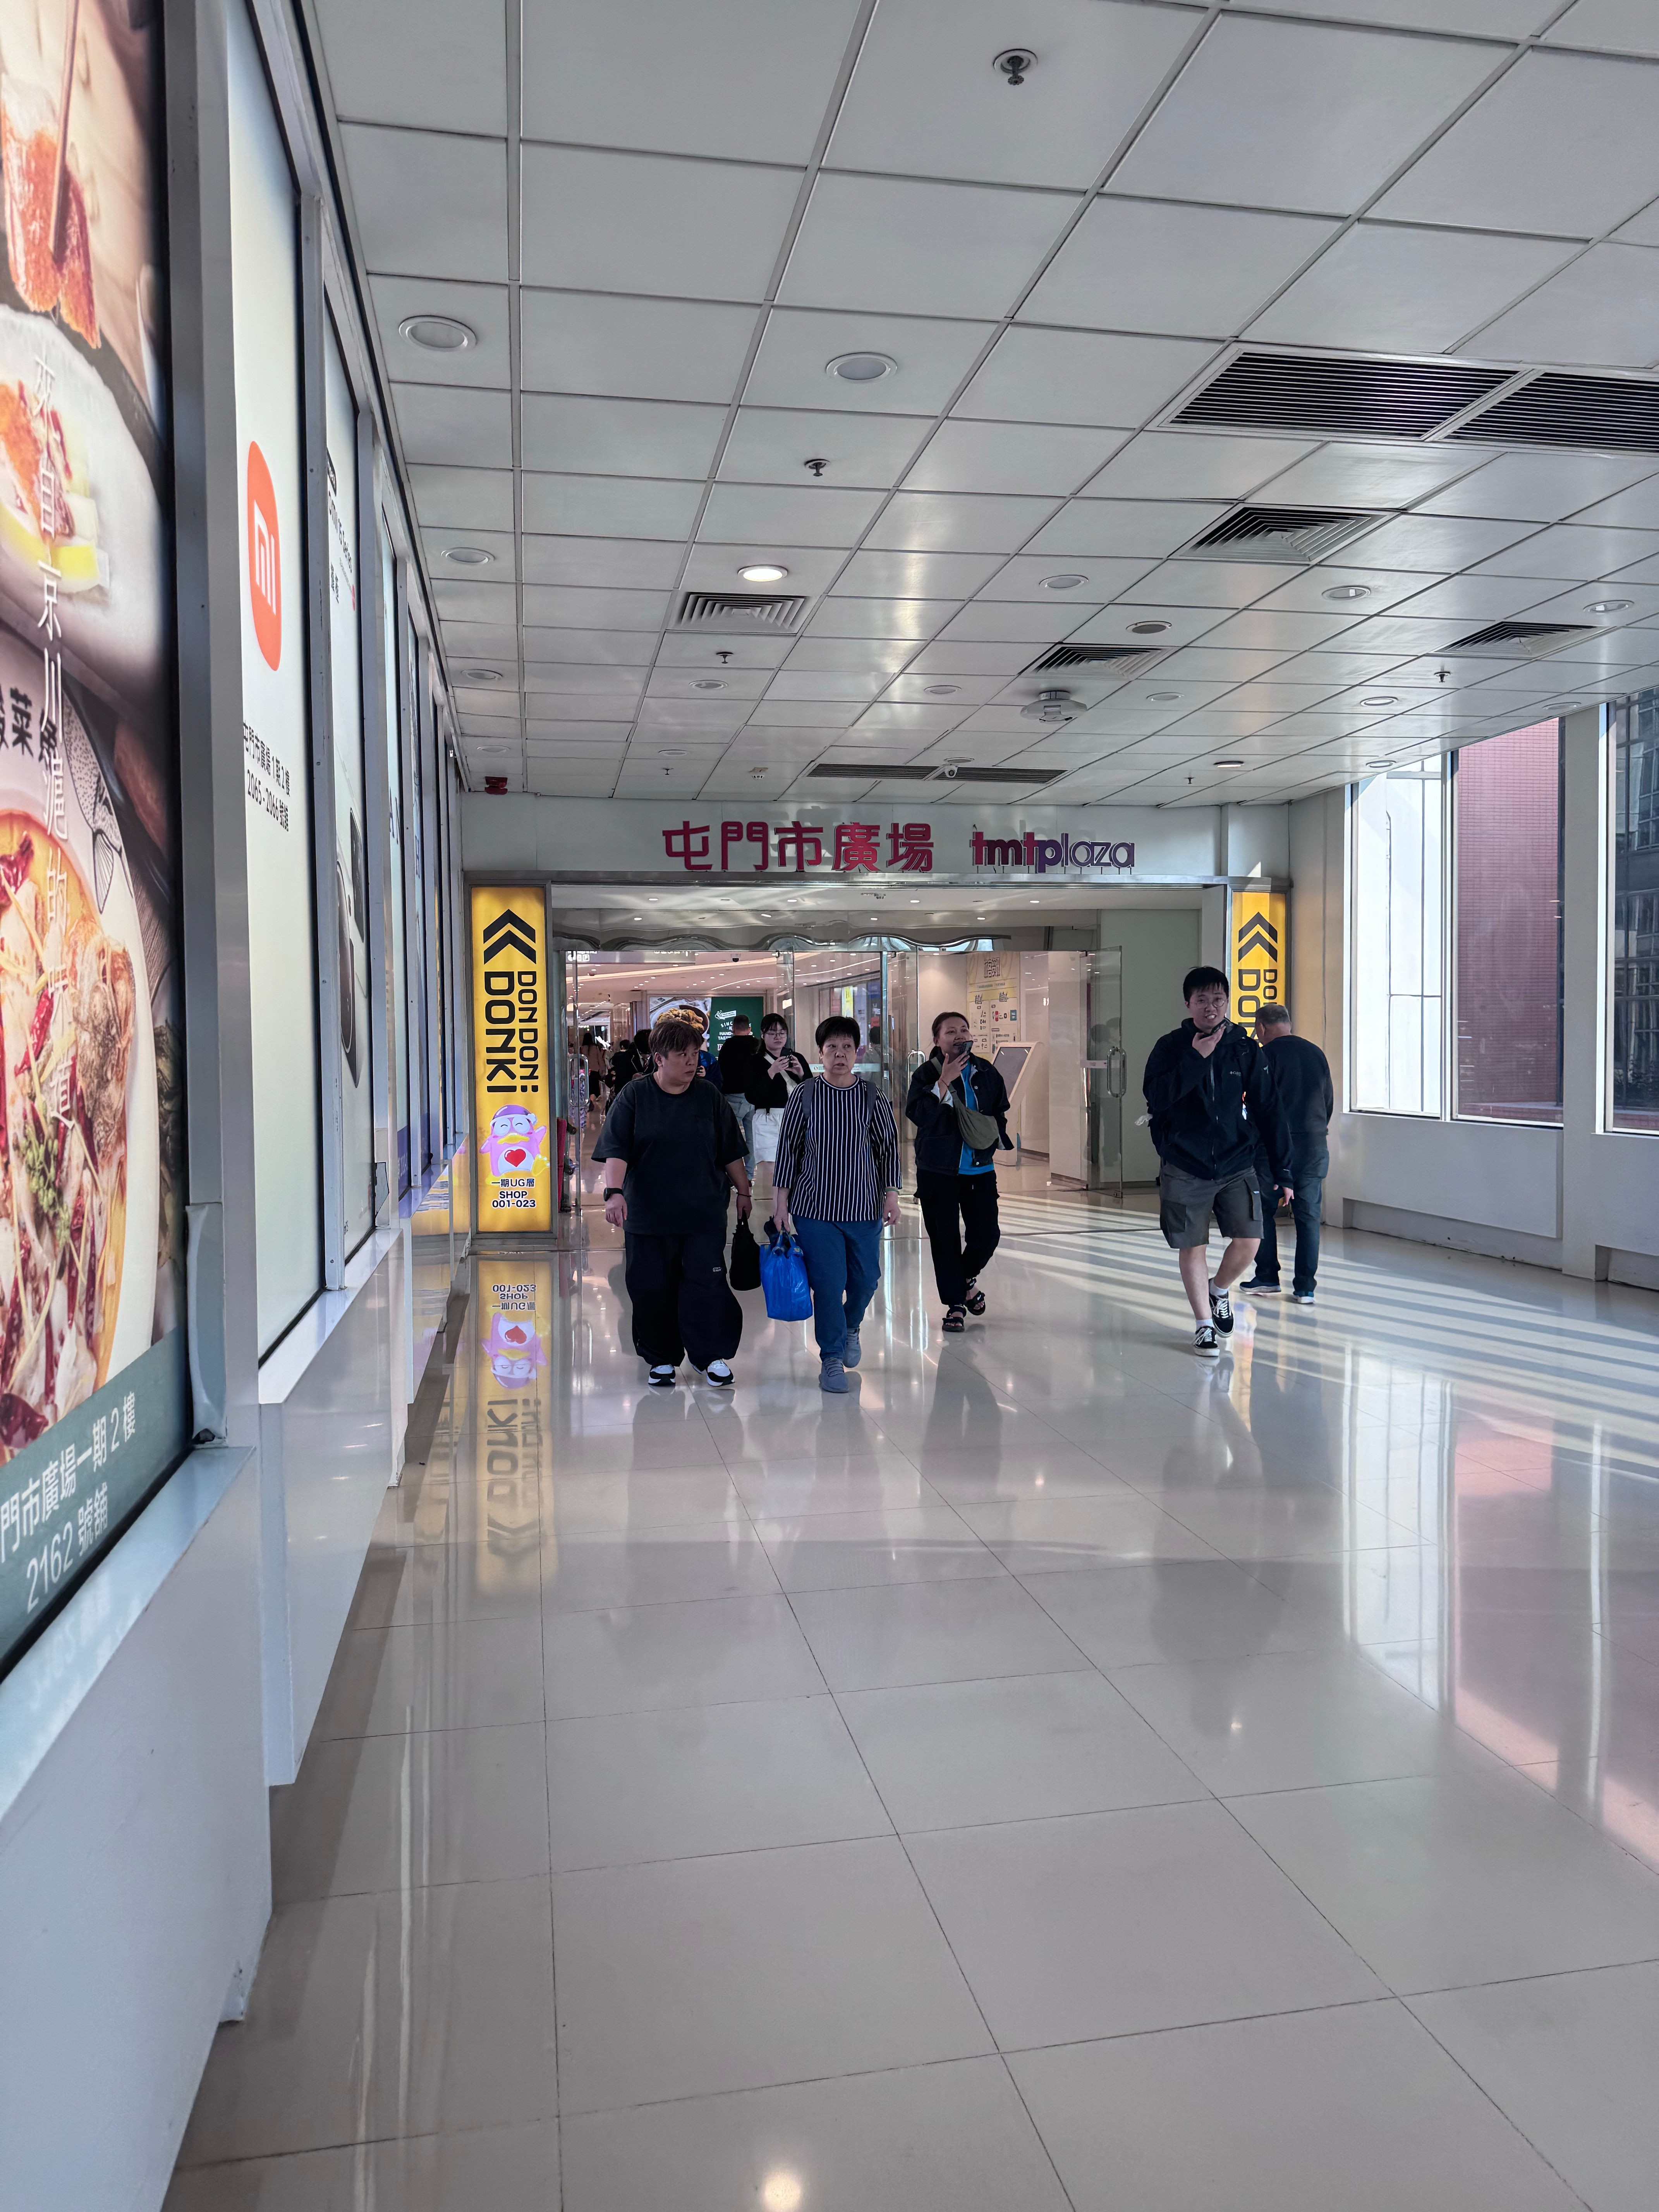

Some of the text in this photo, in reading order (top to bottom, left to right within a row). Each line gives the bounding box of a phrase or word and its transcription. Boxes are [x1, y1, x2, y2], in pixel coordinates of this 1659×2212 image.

[662, 820, 934, 872] 屯門市廣場
[969, 831, 1135, 874] tmtplaza
[1263, 969, 1278, 1004] DO
[484, 971, 517, 1093] DONKI
[517, 971, 539, 1080] DON DON
[492, 1200, 536, 1208] 001-023
[499, 1191, 527, 1199] SHOP
[26, 1521, 74, 1614] 2162
